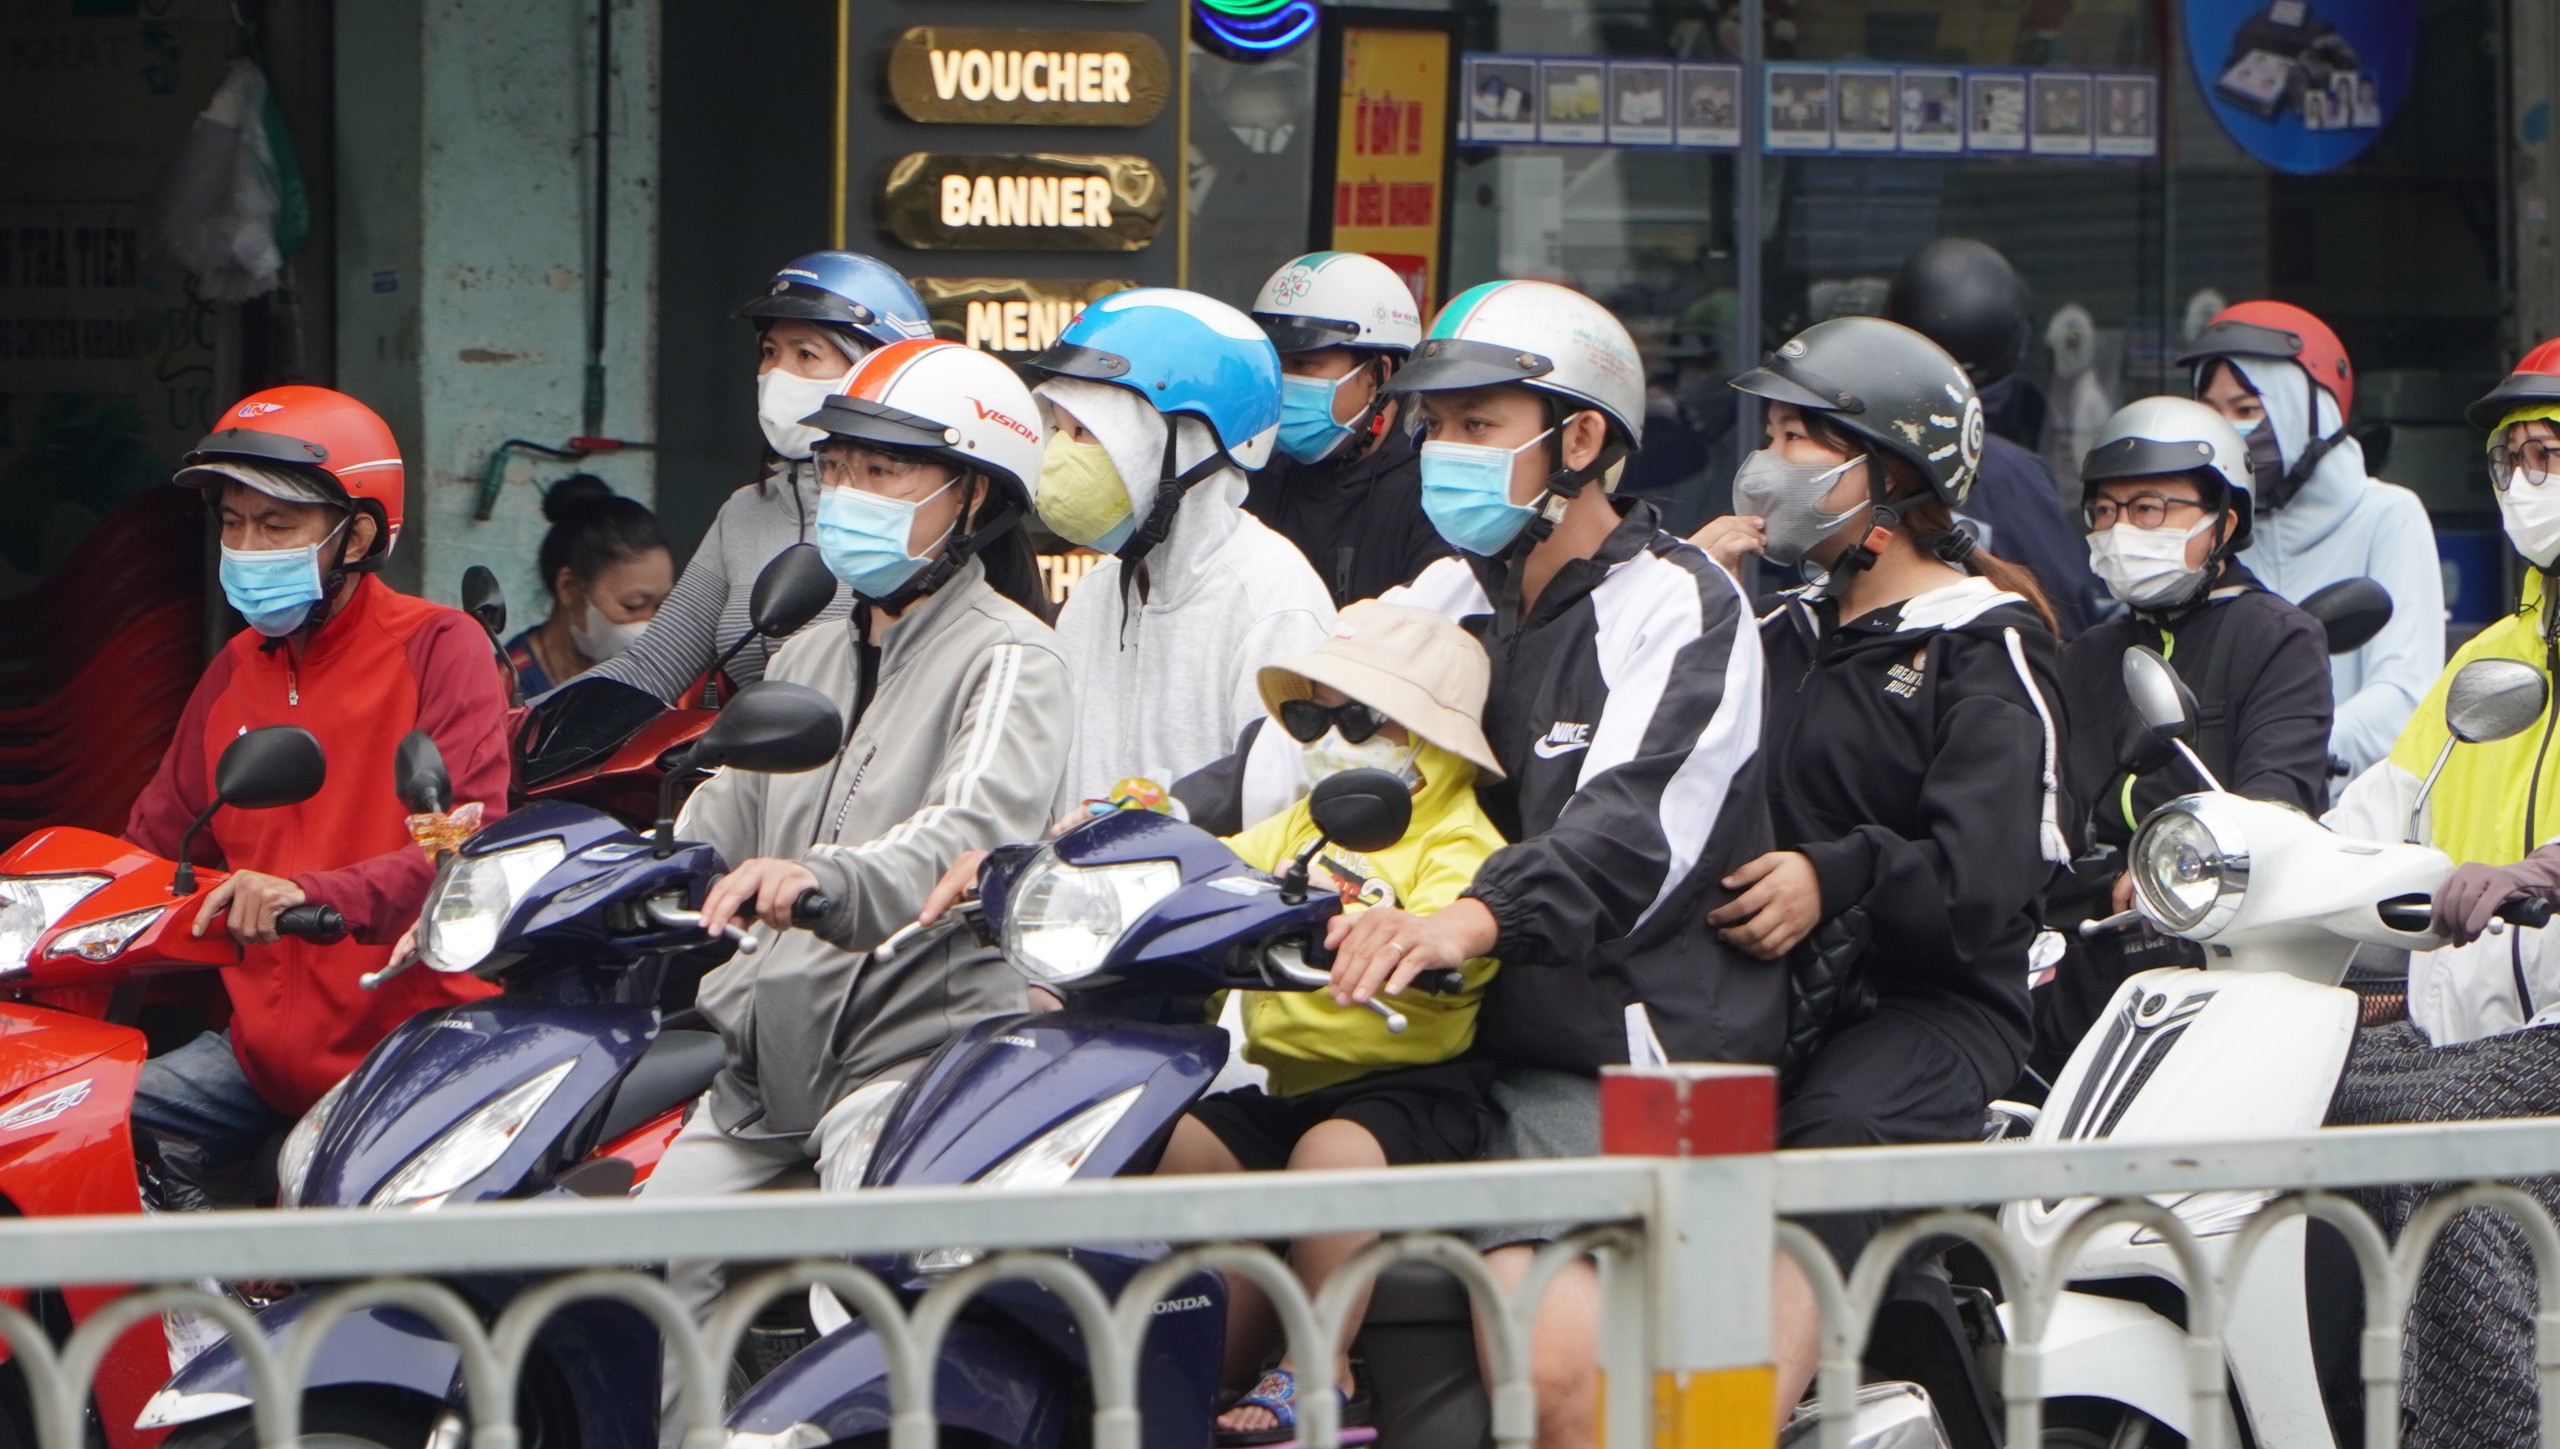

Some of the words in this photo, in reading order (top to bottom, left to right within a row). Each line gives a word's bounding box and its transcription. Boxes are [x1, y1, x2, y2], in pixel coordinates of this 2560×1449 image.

[929, 49, 1132, 103] VOUCHER
[941, 174, 1113, 228] BANNER
[965, 395, 1040, 445] VISION
[1546, 721, 1591, 743] NIKE
[1150, 1294, 1213, 1314] ONDA
